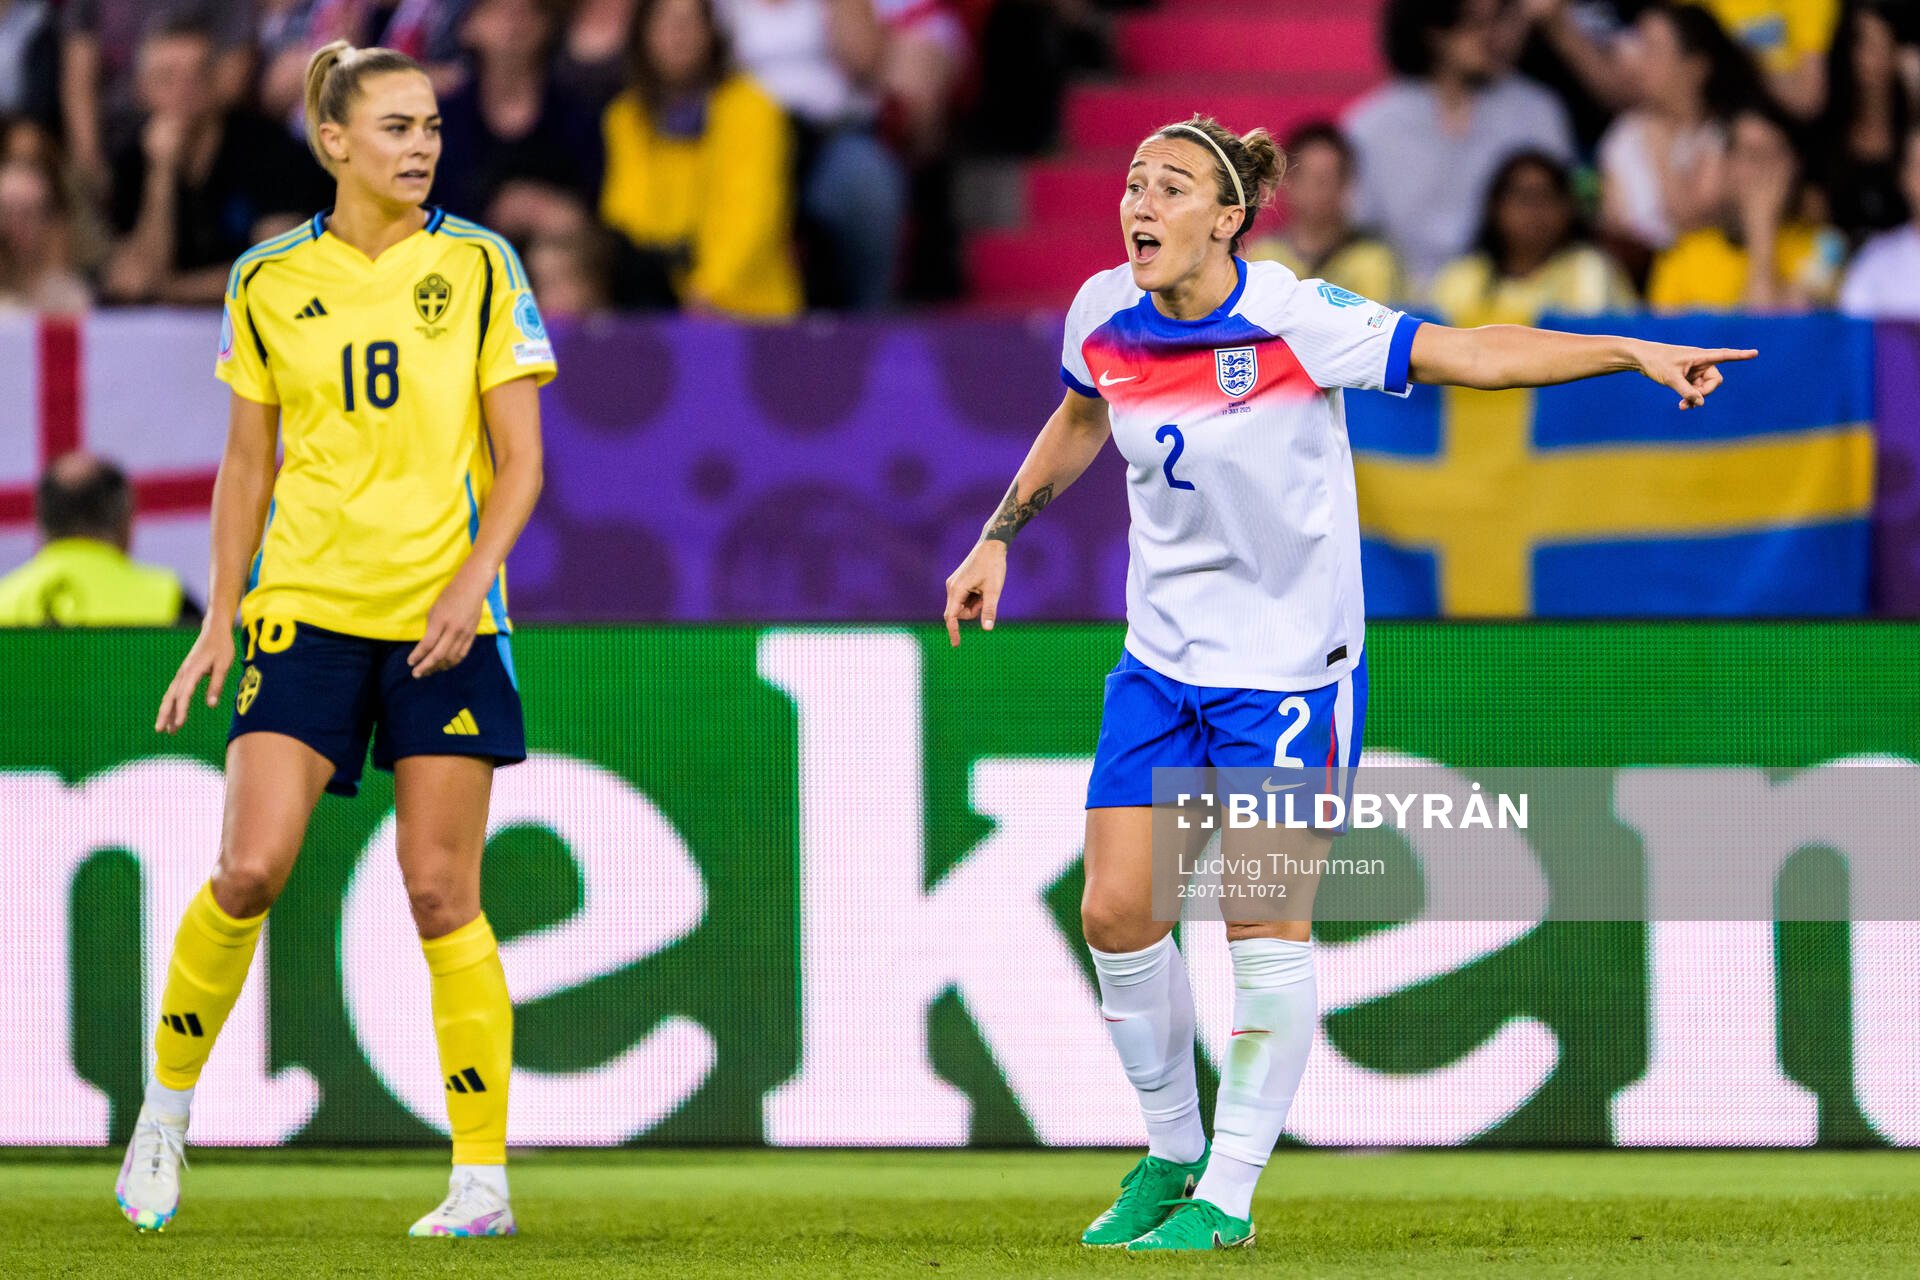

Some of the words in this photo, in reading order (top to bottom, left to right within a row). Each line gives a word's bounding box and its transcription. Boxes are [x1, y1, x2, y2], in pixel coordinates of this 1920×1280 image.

[343, 341, 399, 412] 18
[1155, 424, 1195, 491] 2
[1273, 696, 1311, 770] 2
